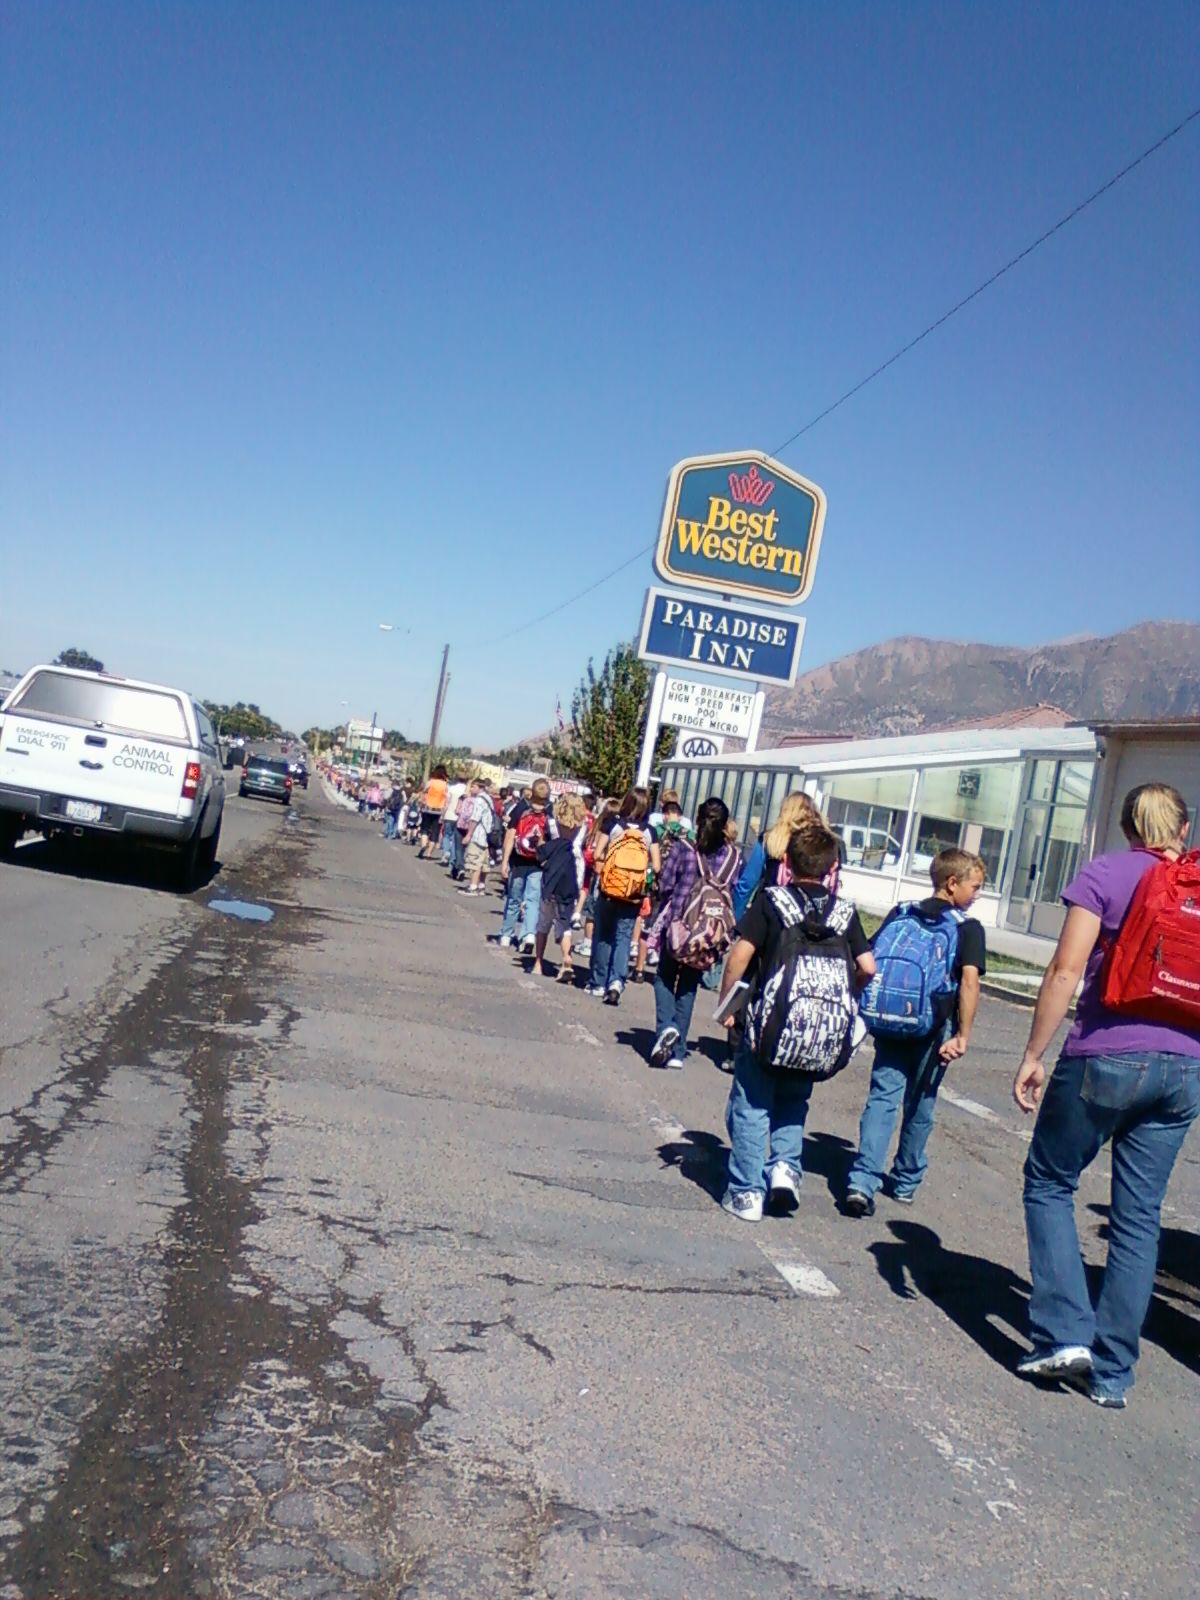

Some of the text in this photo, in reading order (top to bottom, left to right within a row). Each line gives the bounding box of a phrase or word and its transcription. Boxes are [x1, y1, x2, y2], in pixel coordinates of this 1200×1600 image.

[709, 496, 779, 541] Best
[676, 518, 802, 576] Western
[662, 600, 788, 646] PARADISE
[689, 633, 755, 669] INN
[668, 691, 689, 703] HIGH
[695, 696, 723, 710] SPEED
[671, 681, 752, 705] CONT BREAKFAST
[16, 726, 70, 742] EMERGENCY
[671, 712, 739, 734] FRIDGE MICRO
[17, 734, 66, 751] DIAL 911
[120, 744, 171, 763] ANIMAL
[112, 755, 175, 777] CONTROL
